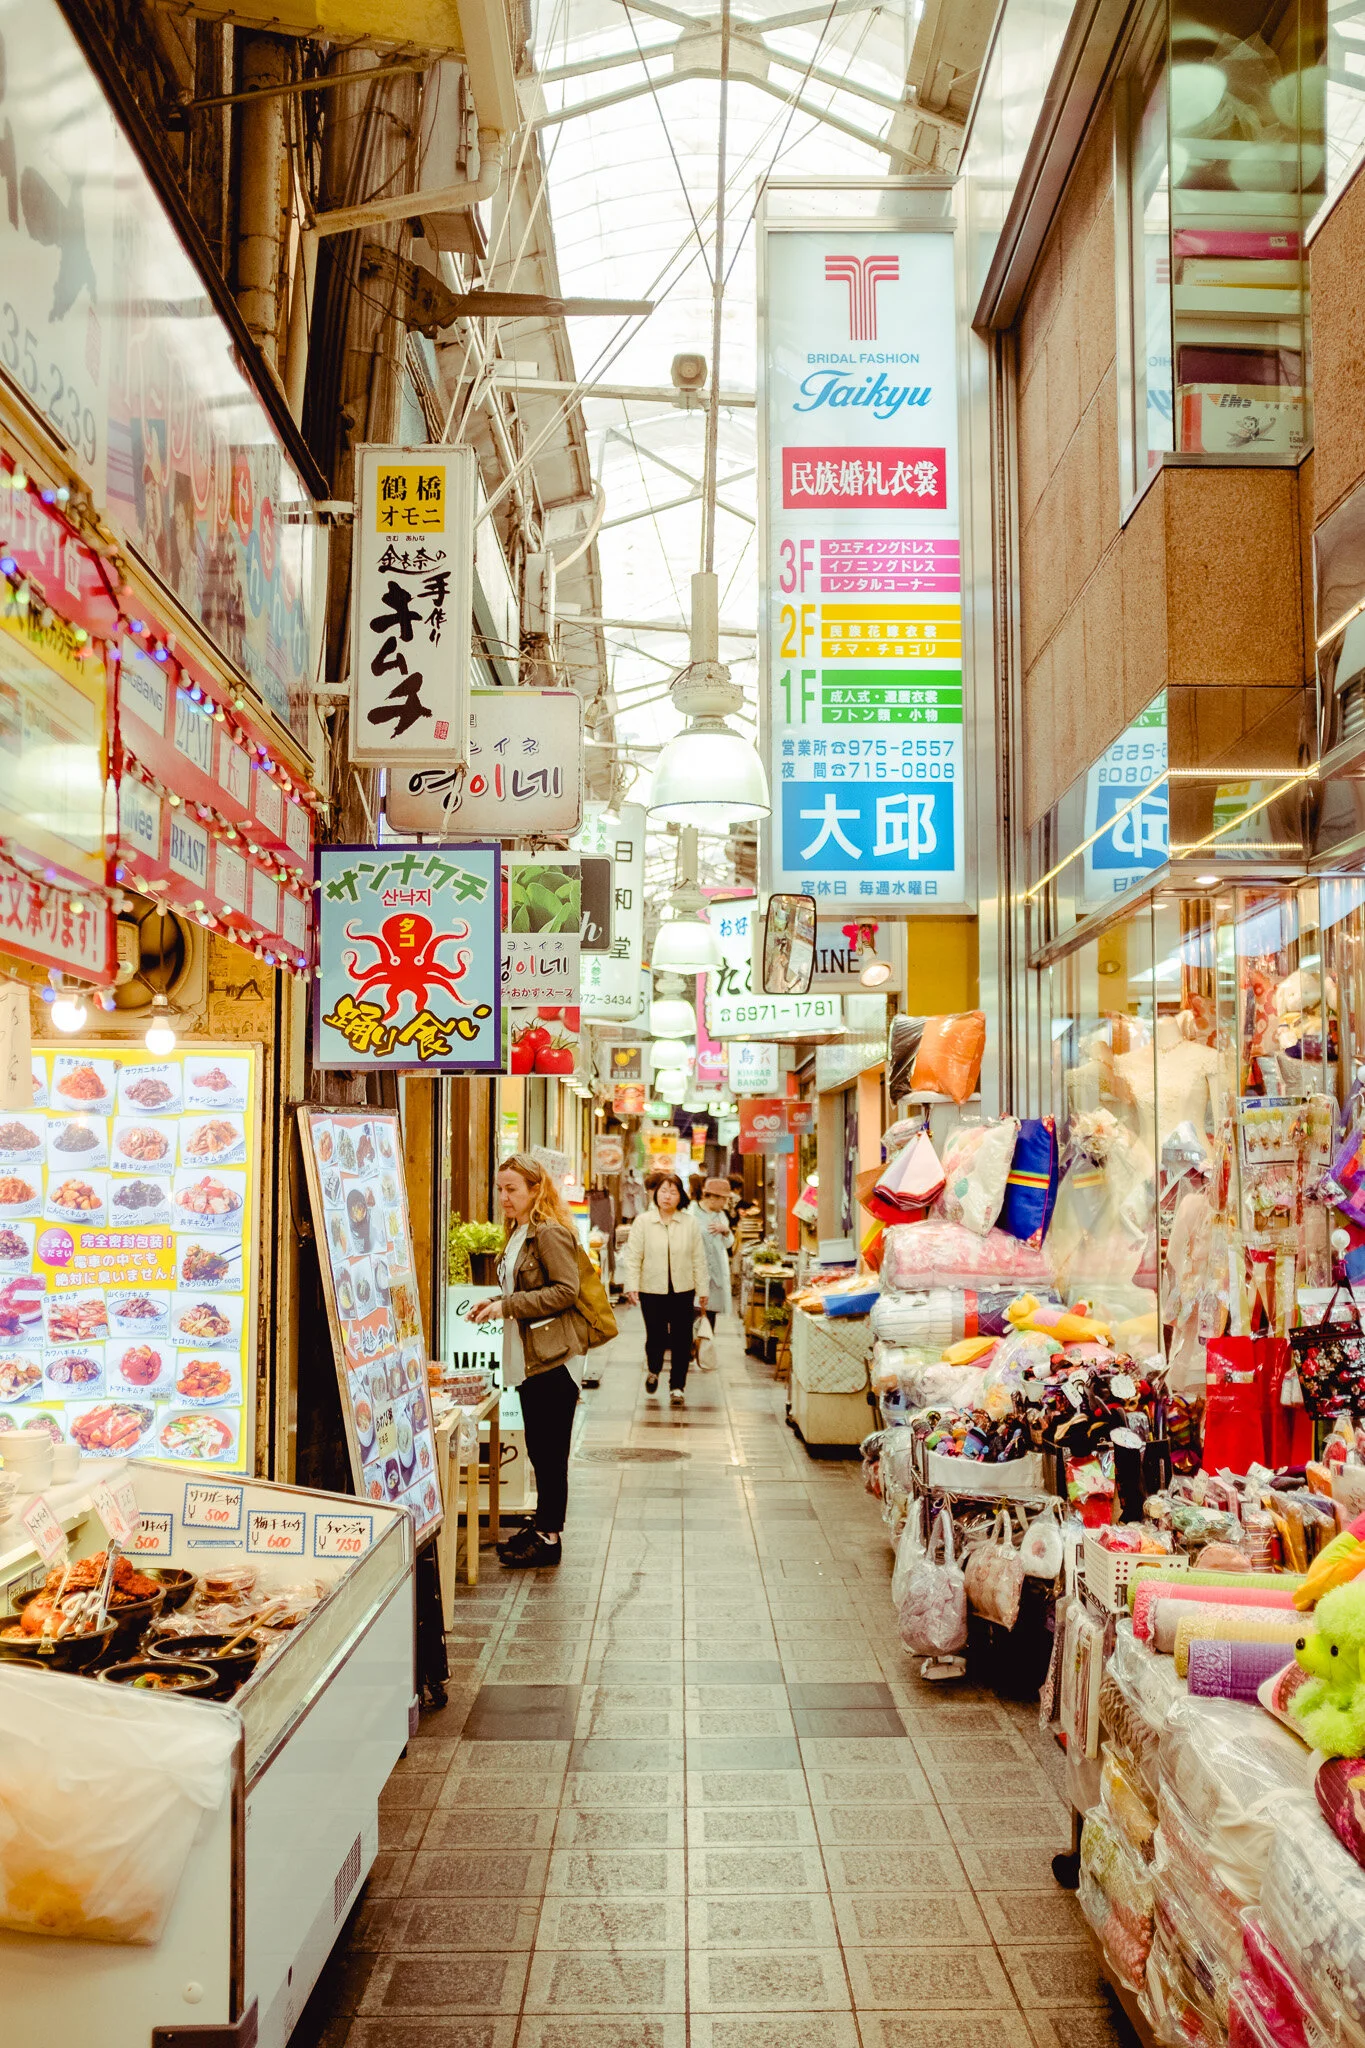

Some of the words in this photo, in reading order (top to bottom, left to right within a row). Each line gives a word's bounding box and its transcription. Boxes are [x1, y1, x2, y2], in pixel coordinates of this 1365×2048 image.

[807, 353, 857, 364] BRIDAL
[859, 353, 920, 364] FASHION
[793, 369, 932, 420] Taikyu
[381, 474, 442, 502] 鶴橋
[789, 460, 940, 498] 民族婚礼衣裳
[380, 505, 441, 526] オモニ
[779, 538, 815, 594] 3F
[829, 578, 936, 591] レンタルコーナー
[416, 571, 451, 648] 手作り
[779, 603, 816, 658] 2F
[366, 581, 433, 740] キムチ
[779, 669, 816, 724] 1F
[781, 739, 828, 757] 営業所
[847, 739, 955, 757] 975-2557
[848, 761, 955, 779] 715-0808
[407, 764, 561, 813] 영이네
[799, 792, 938, 862] 大邱
[170, 823, 207, 878] BEAST
[325, 854, 489, 903] サンナクチ
[800, 880, 848, 895] 定休日
[859, 879, 938, 896] 毎週水曜日
[381, 888, 432, 907] 산낙지
[609, 841, 633, 960] 日和堂
[398, 917, 417, 948] タコ
[736, 1000, 833, 1022] 6971-1781
[325, 995, 492, 1062] 踊り食い
[125, 1065, 169, 1075] サワガニキムチ
[737, 1078, 768, 1087] BANDO
[73, 1253, 158, 1270] 電車の中でも
[110, 1385, 145, 1394] トマトキムチ
[204, 1508, 230, 1522] 500
[134, 1534, 161, 1550] 500
[267, 1534, 292, 1549] 600
[335, 1537, 362, 1552] 750
